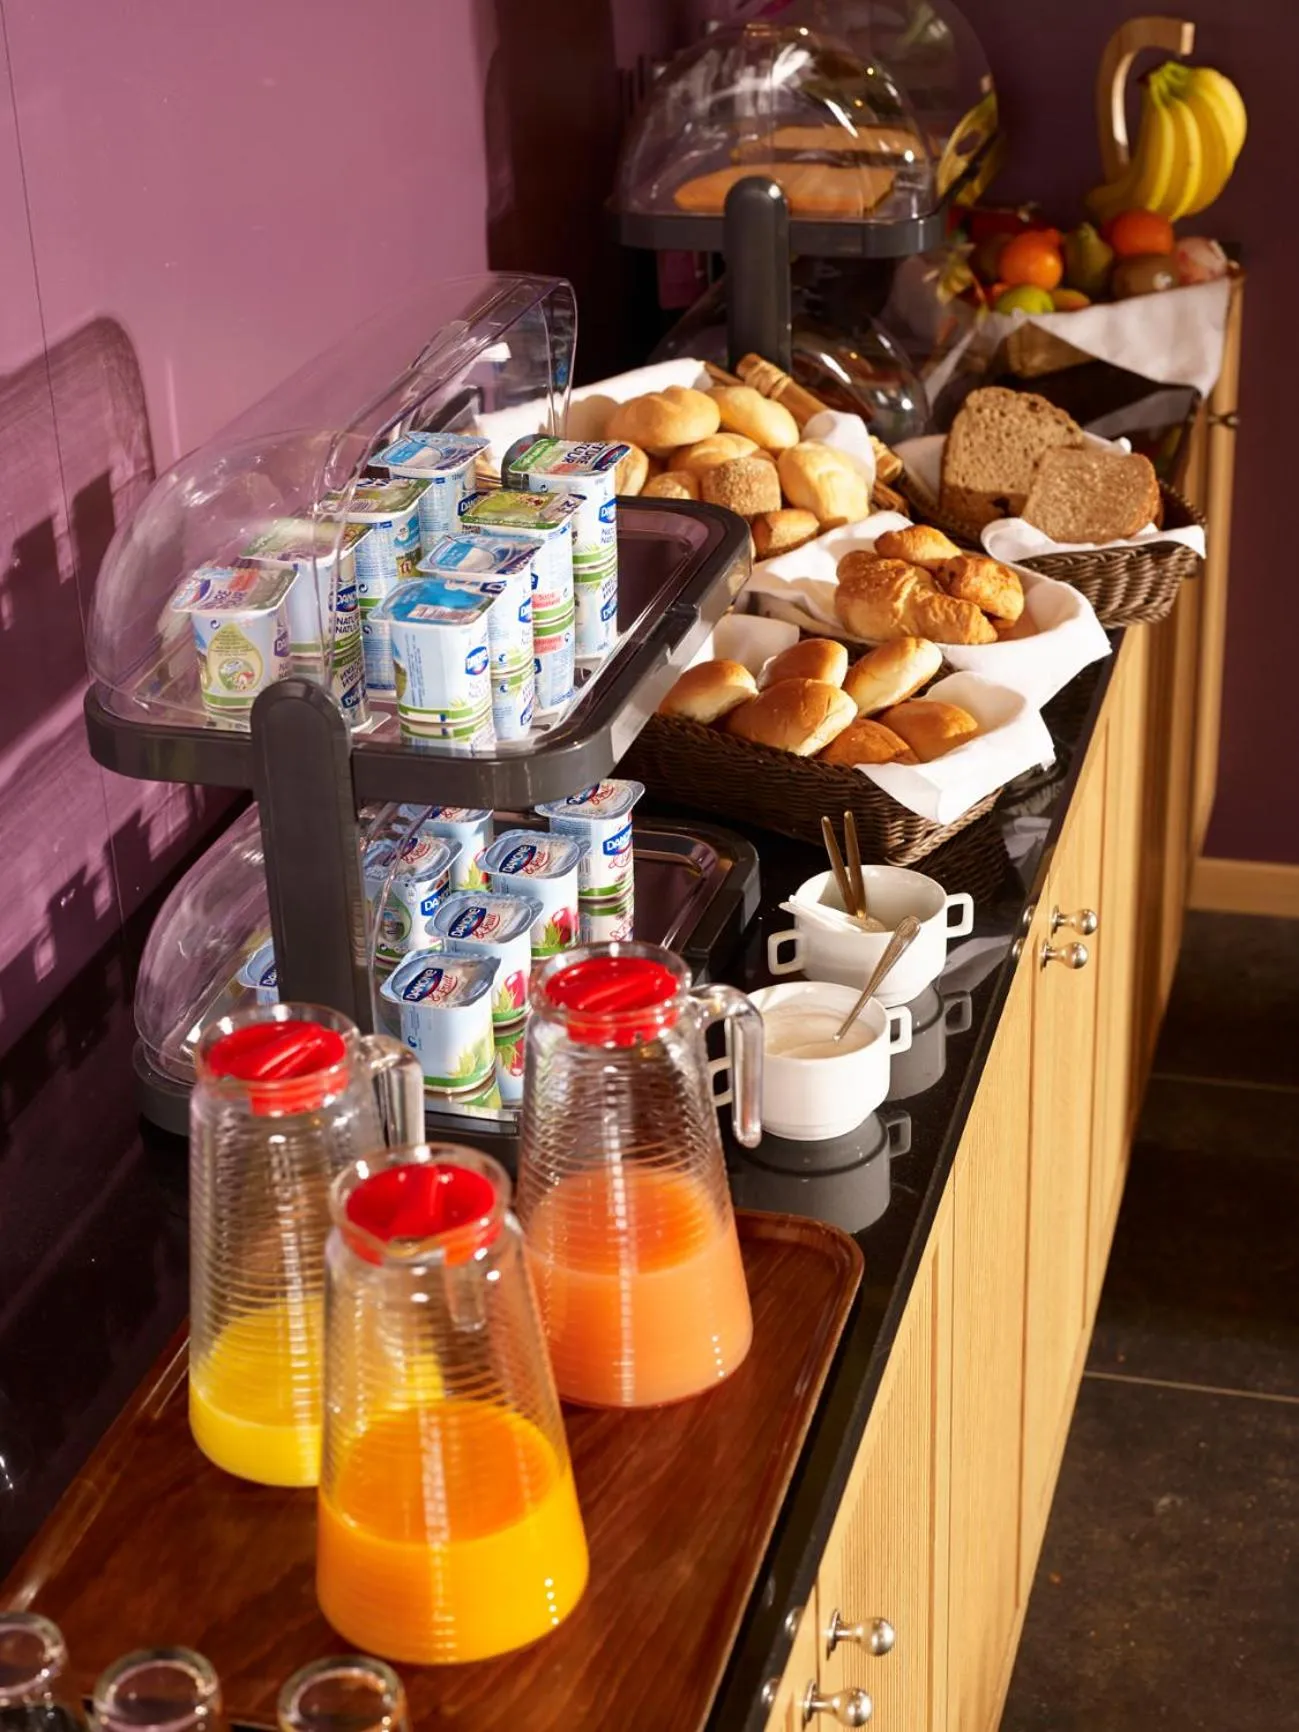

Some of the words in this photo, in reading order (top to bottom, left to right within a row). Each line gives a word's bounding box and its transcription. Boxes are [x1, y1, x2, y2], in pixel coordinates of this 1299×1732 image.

[501, 845, 530, 872] DANONE
[451, 908, 481, 936] DANONE
[405, 969, 437, 999] DANONE
